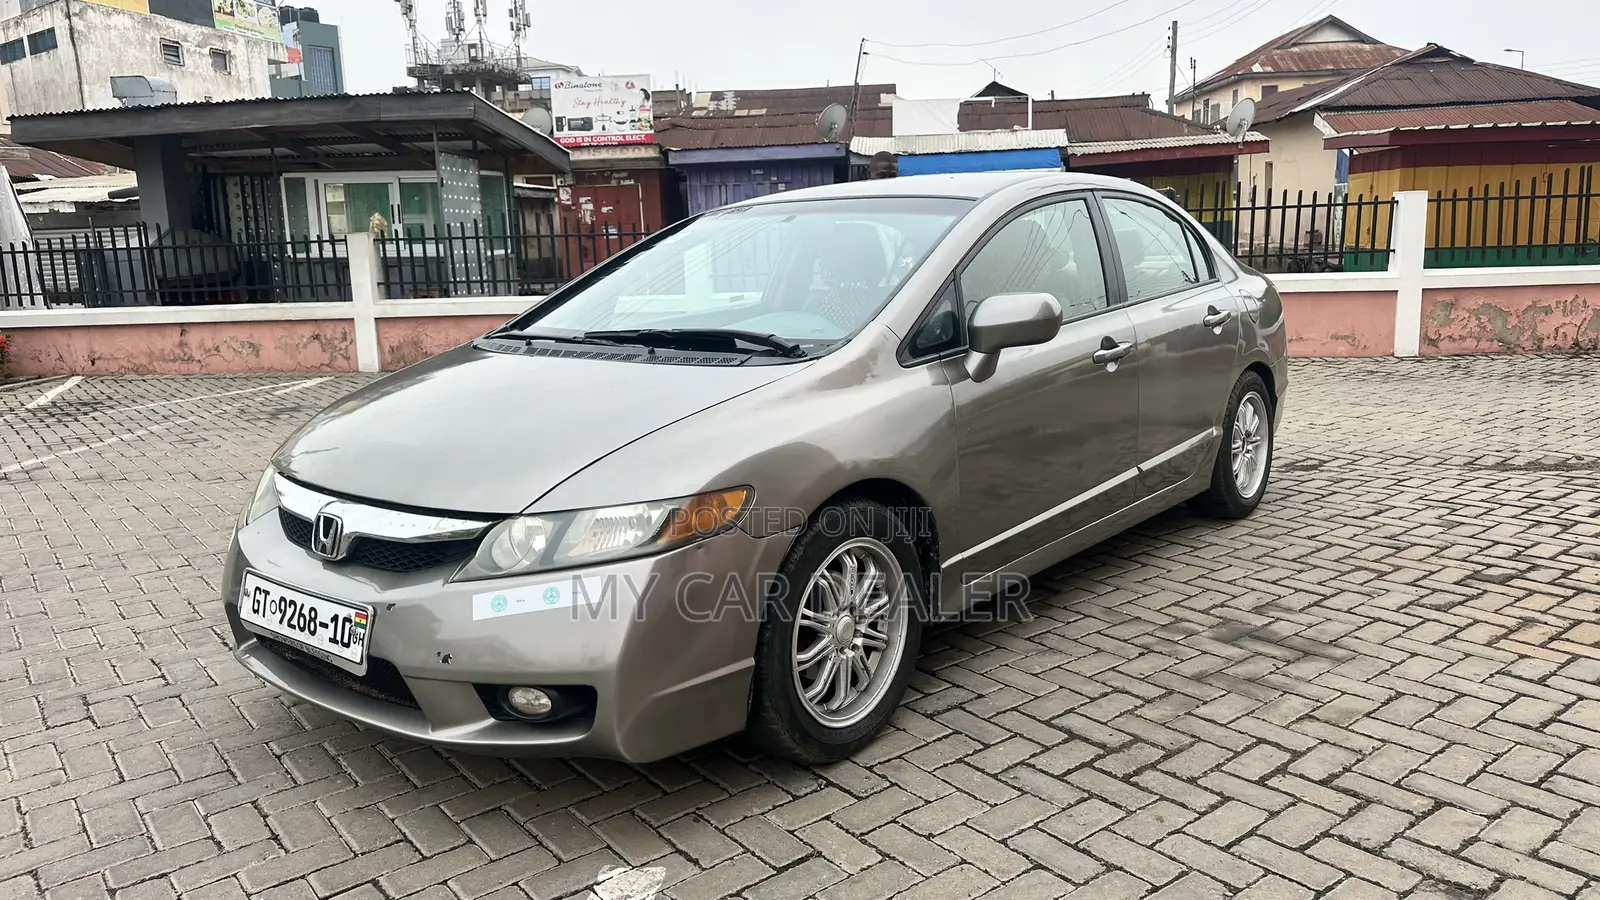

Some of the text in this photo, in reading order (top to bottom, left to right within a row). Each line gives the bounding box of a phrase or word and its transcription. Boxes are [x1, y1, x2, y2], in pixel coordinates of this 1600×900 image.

[564, 81, 603, 90] Binatone
[573, 96, 626, 109] Stay Healthy
[592, 134, 624, 142] CONTROL
[252, 586, 271, 619] GT
